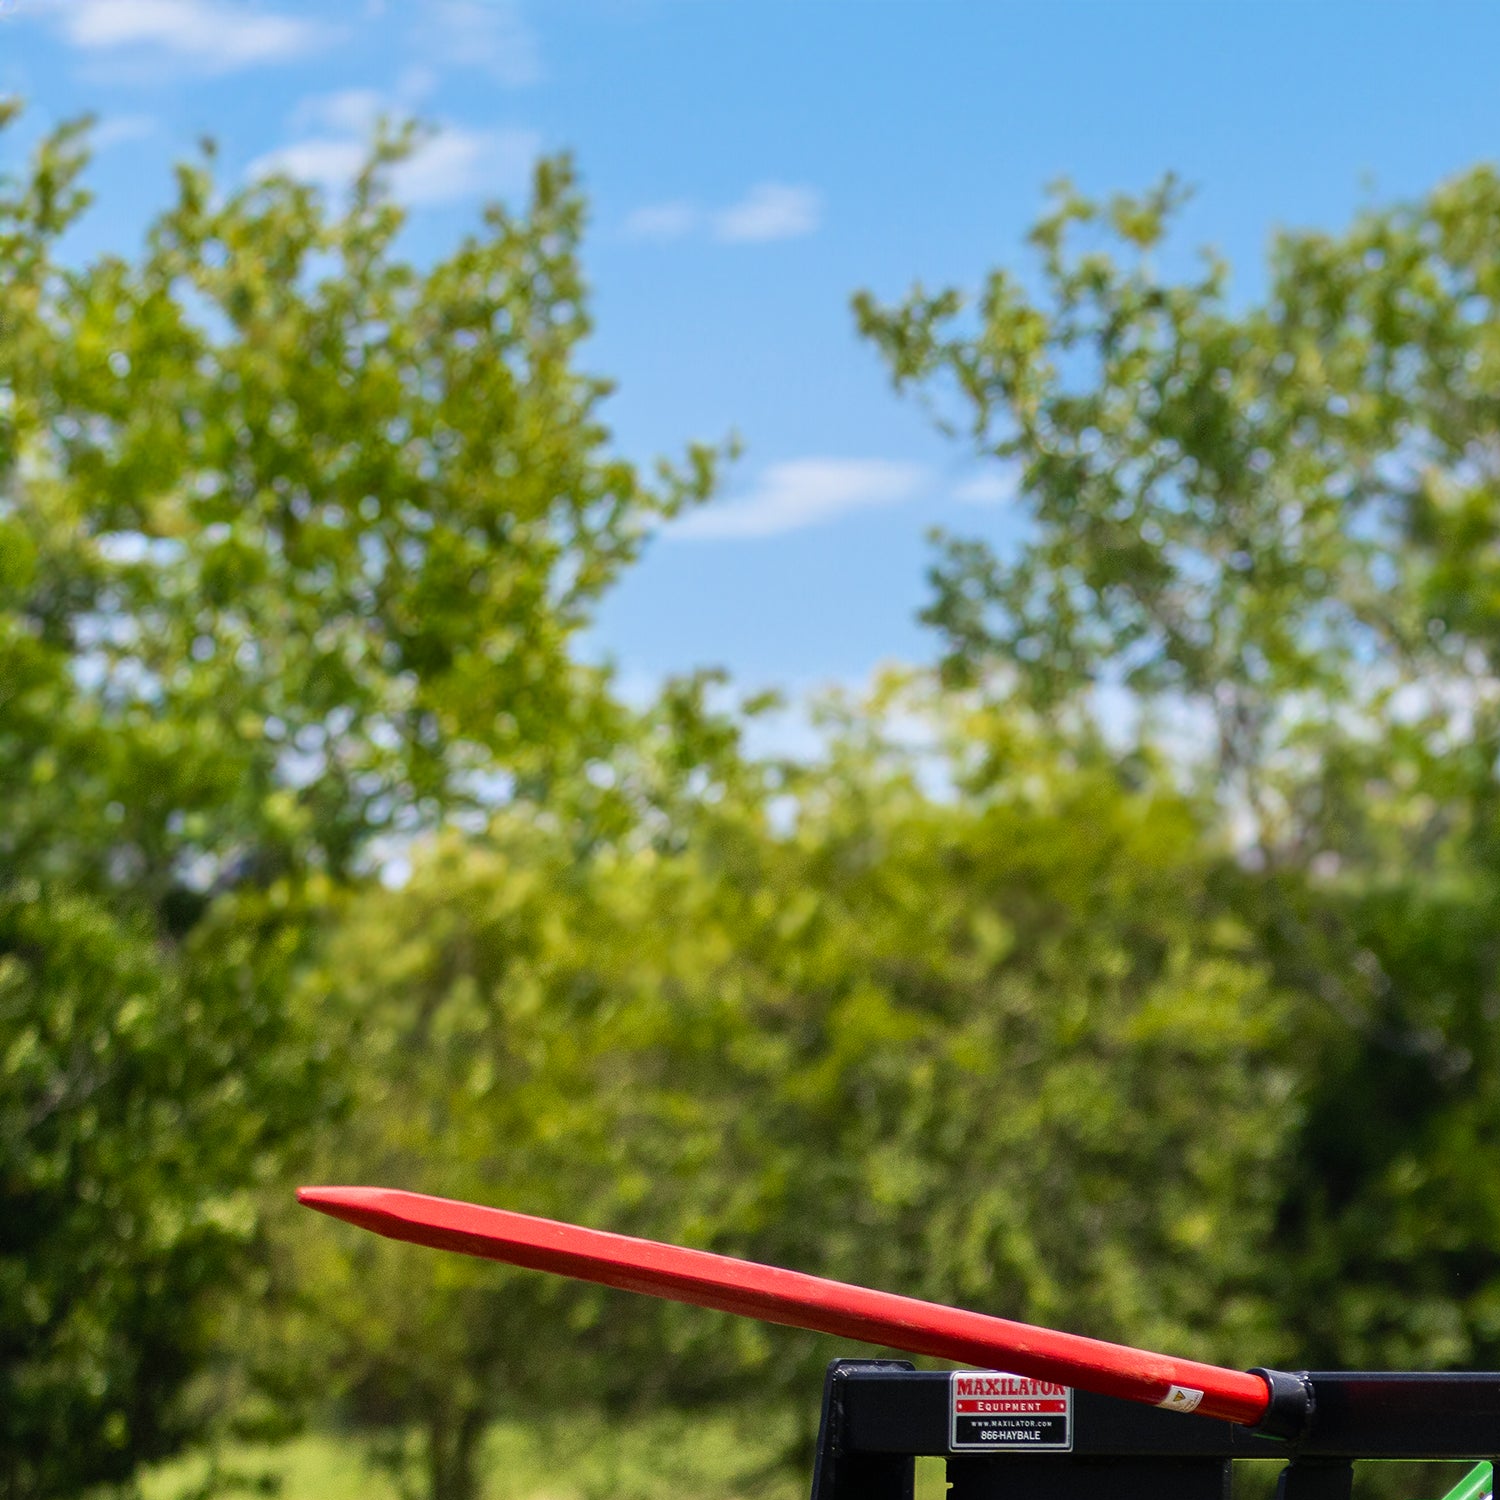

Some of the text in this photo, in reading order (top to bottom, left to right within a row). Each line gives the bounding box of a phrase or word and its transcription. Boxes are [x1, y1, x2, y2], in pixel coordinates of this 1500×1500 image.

[957, 1378, 1066, 1396] MAXILATOR
[977, 1401, 1042, 1412] EQUIPMENT
[980, 1430, 1041, 1441] 866-HAYBALE
